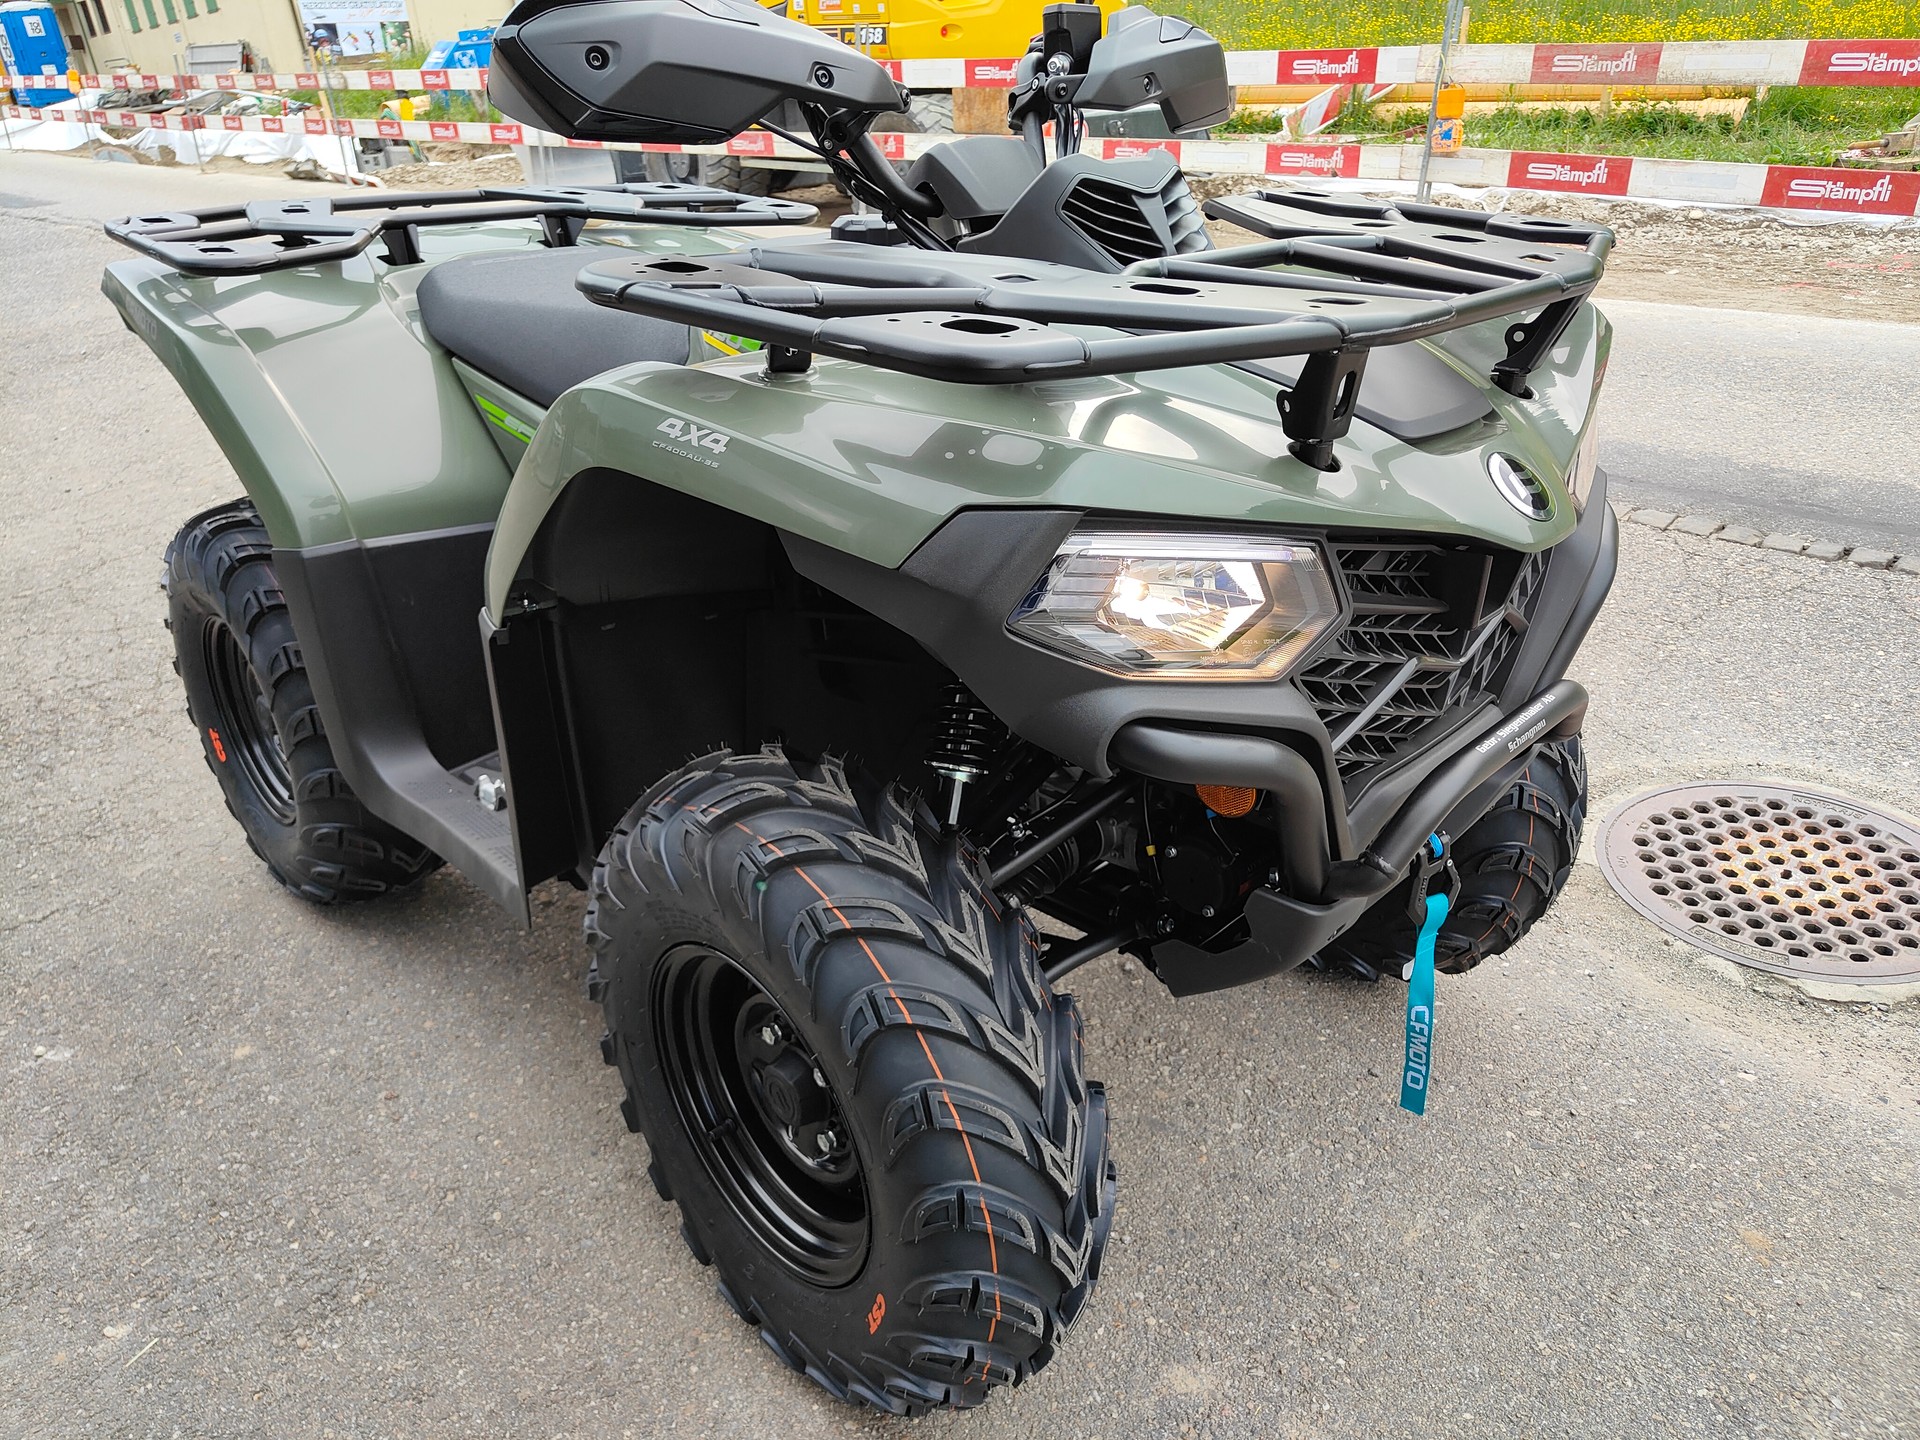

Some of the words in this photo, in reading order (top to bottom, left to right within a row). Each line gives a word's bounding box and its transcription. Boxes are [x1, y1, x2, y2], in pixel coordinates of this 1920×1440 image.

[1292, 51, 1359, 78] Stämpfli
[1551, 46, 1638, 76] Stämpfli
[1827, 52, 1920, 77] Stämp
[1280, 147, 1345, 171] Stämpfli
[1526, 159, 1608, 187] Stämpfli
[1787, 175, 1893, 205] Stämpfli
[656, 417, 731, 455] 4X4
[1475, 736, 1501, 754] Gebr.
[1496, 701, 1545, 739] Siegenthaler
[1541, 693, 1556, 705] AG
[1507, 719, 1547, 753] Schangnau
[1406, 1005, 1430, 1091] CFMOTO
[867, 1293, 886, 1335] CST
